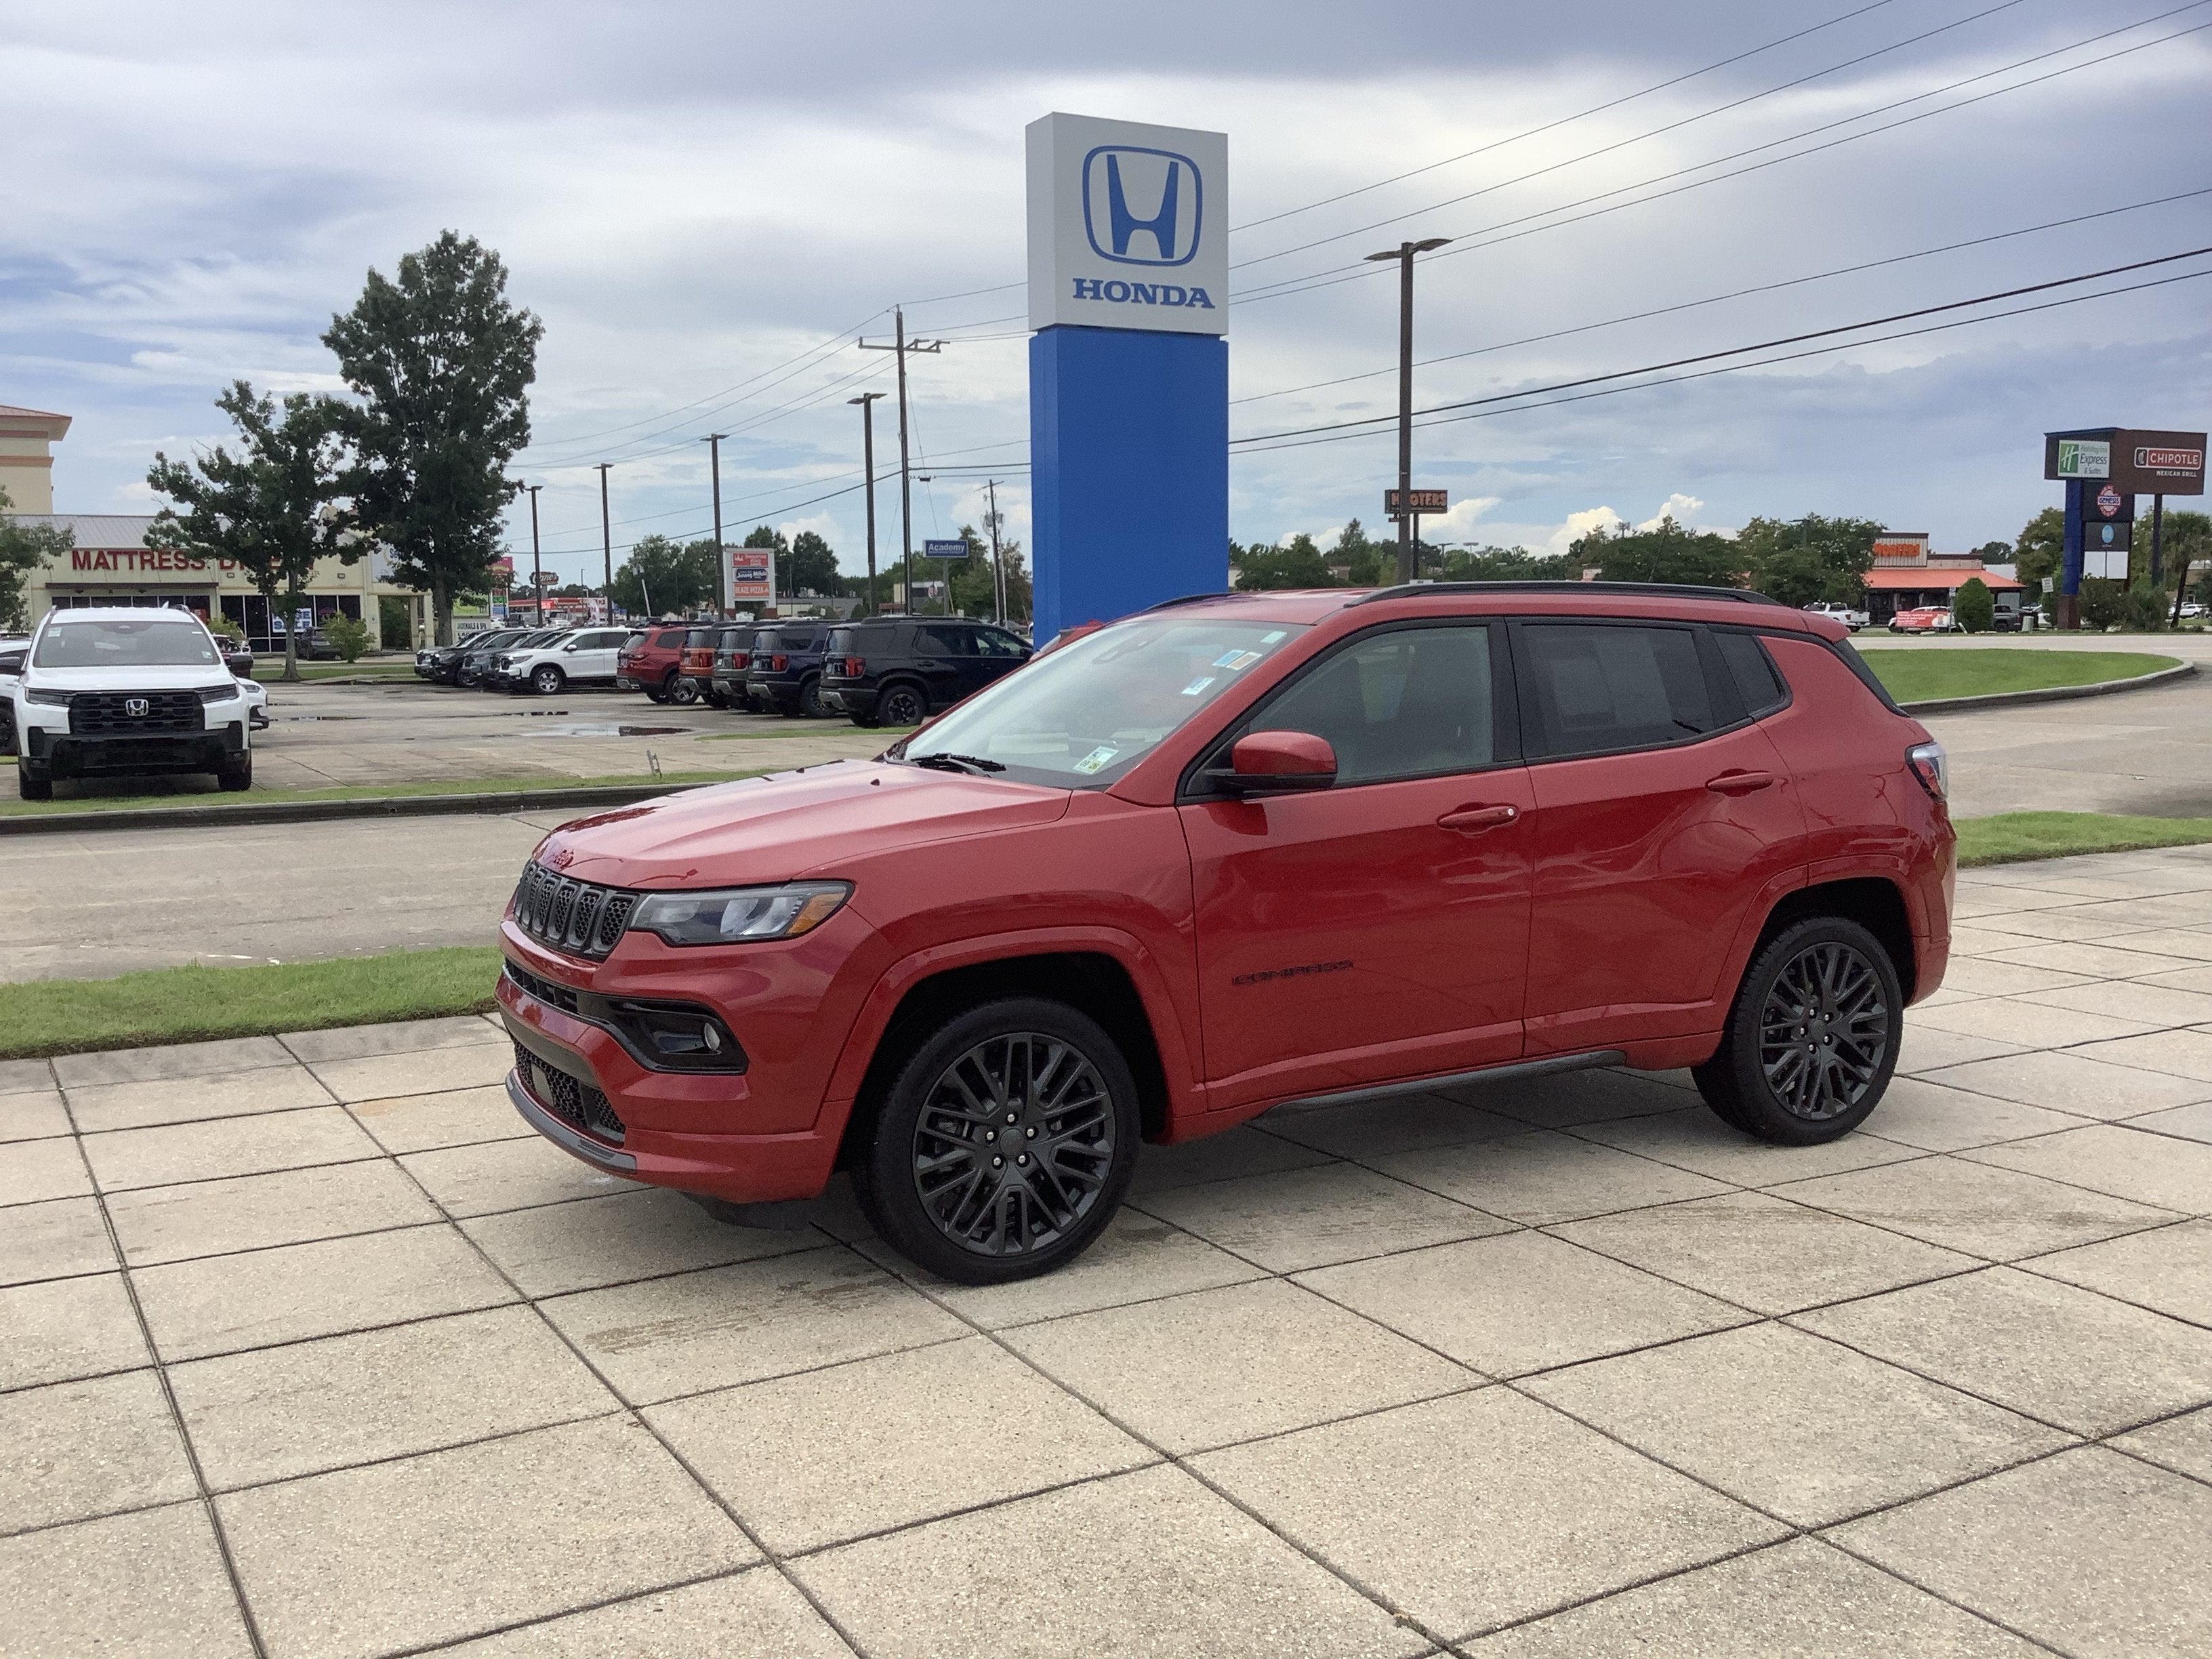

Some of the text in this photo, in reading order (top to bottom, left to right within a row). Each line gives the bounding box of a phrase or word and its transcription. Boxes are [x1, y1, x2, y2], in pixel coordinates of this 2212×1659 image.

[1073, 278, 1215, 309] HONDA
[2080, 453, 2107, 466] Express
[2150, 453, 2198, 464] CHIPOTLE
[1391, 492, 1446, 506] HOTERS
[928, 543, 965, 553] Academy
[72, 550, 205, 571] MATTRESS
[274, 621, 310, 630] SLE
